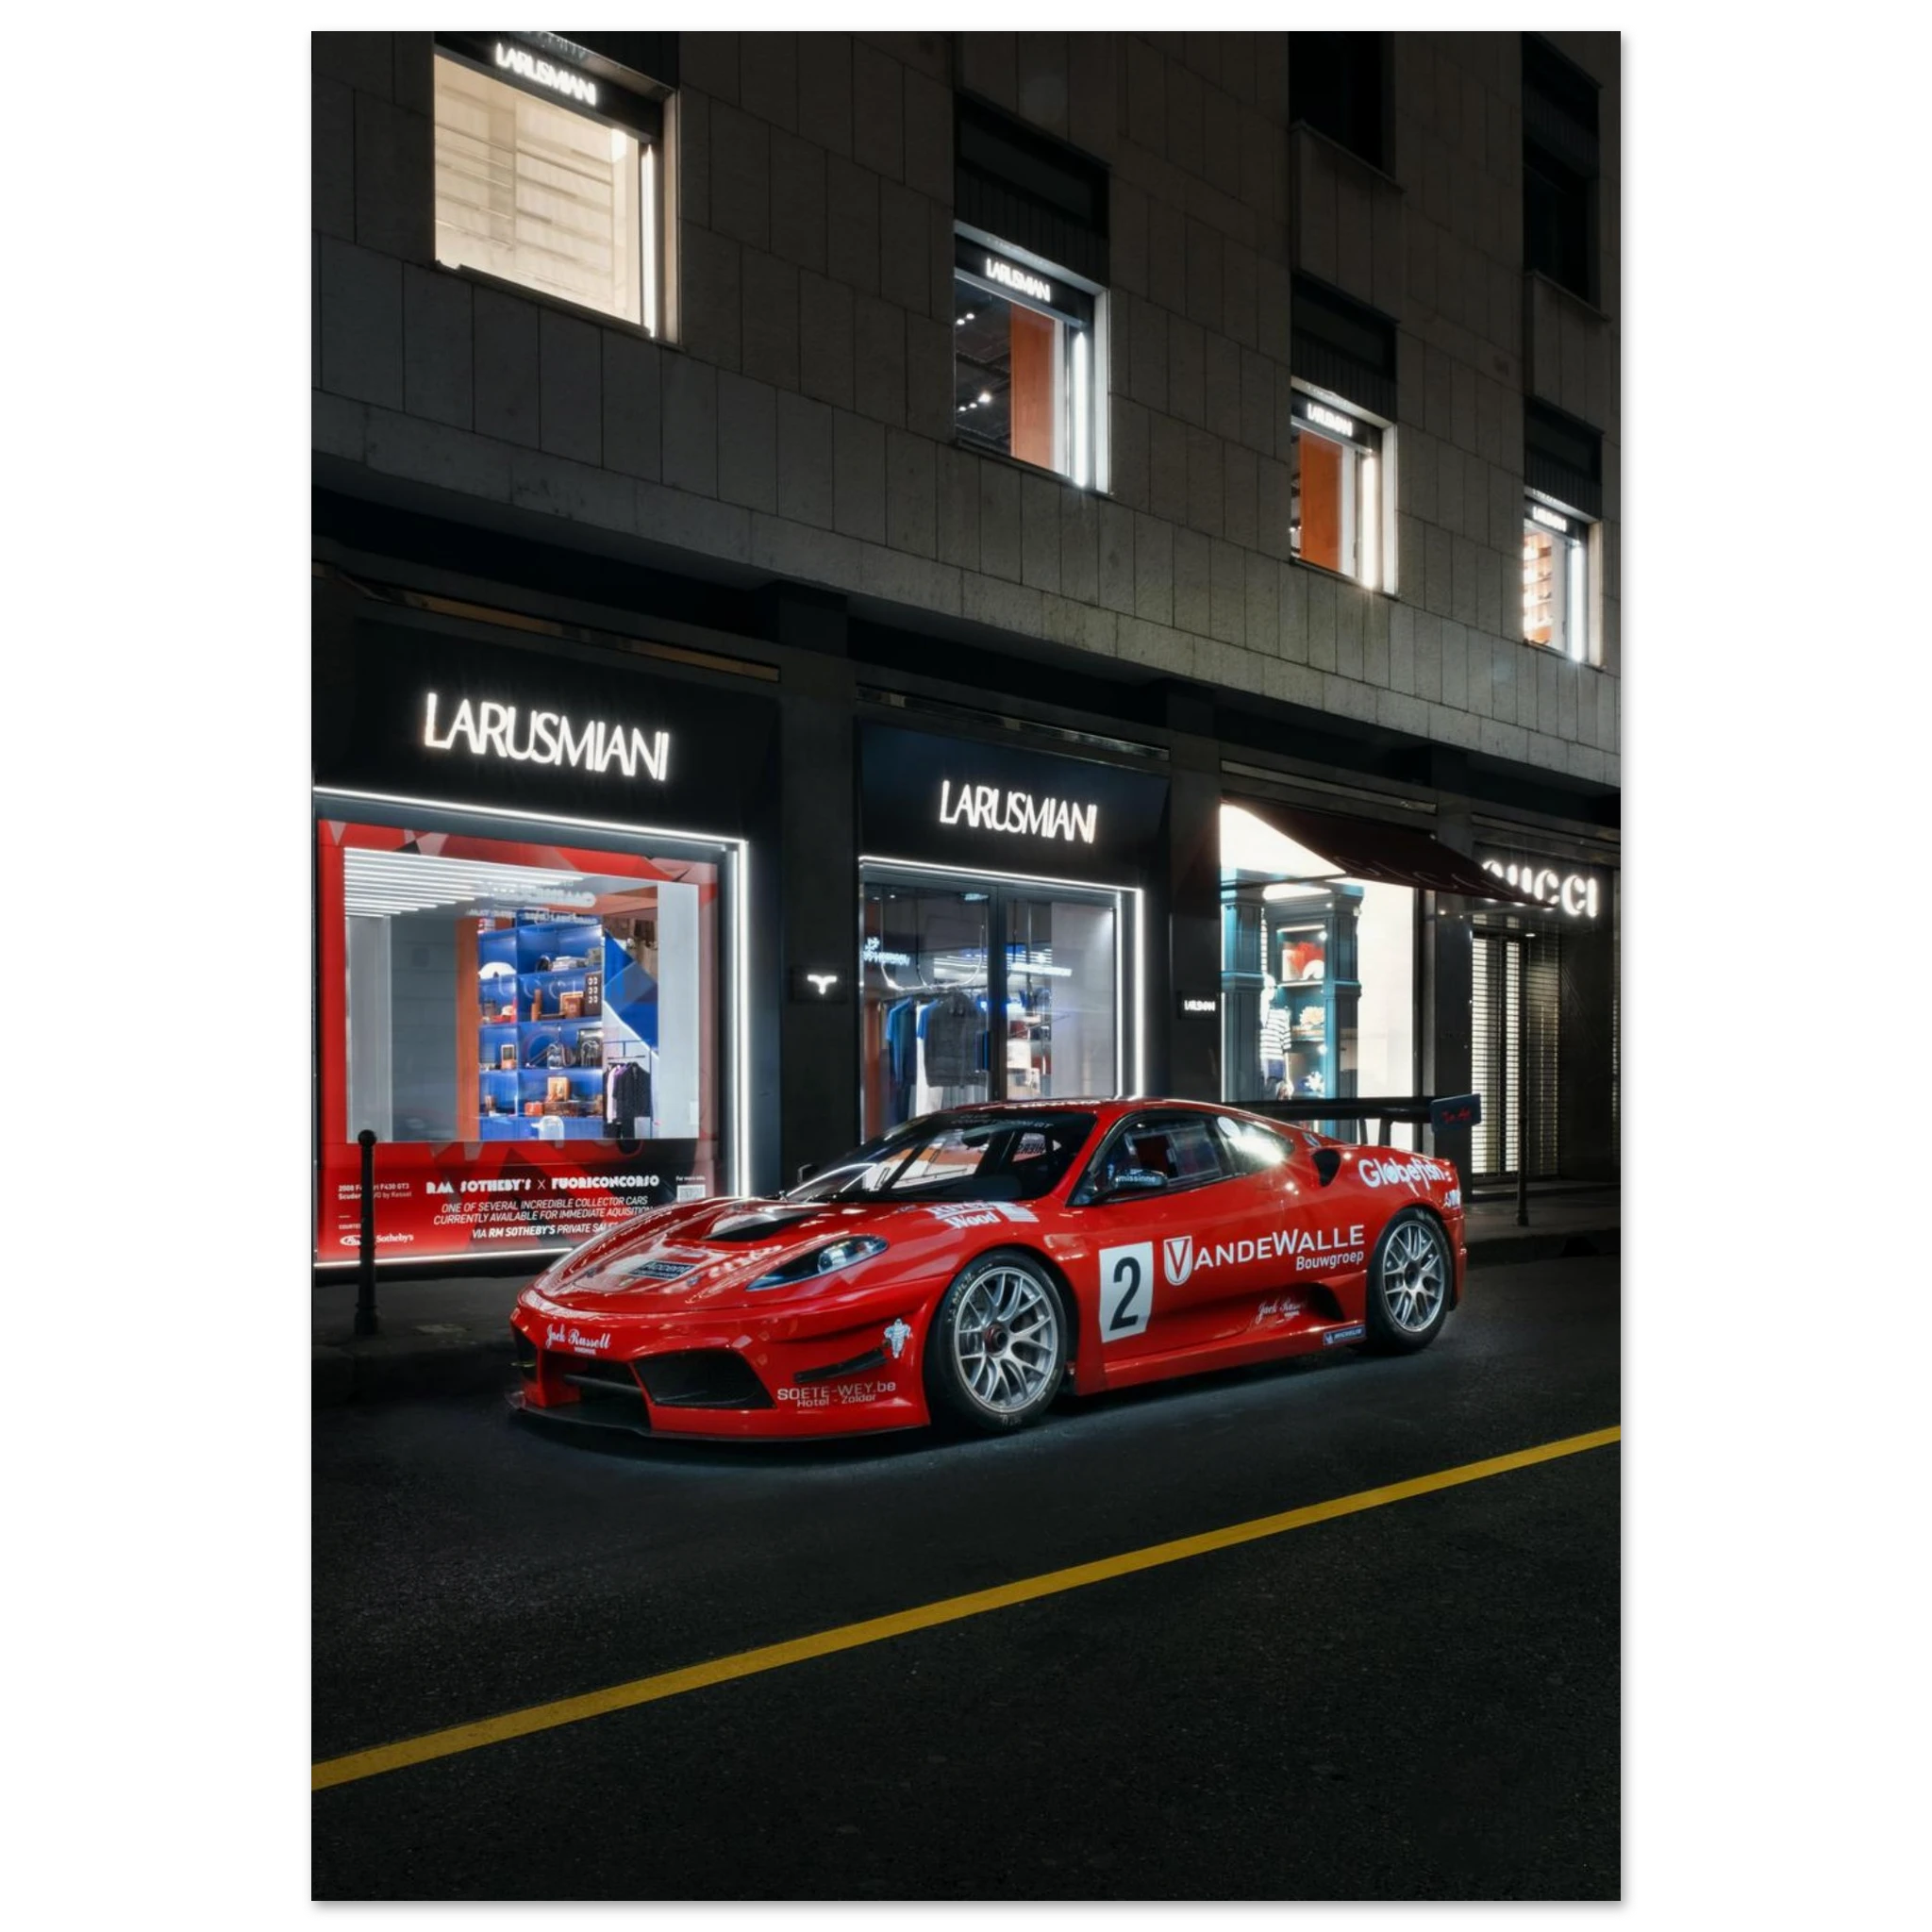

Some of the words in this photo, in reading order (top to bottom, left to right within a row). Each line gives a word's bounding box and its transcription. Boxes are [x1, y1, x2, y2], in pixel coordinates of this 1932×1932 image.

[424, 691, 670, 781] LARUSMIANI
[940, 779, 1098, 844] LARUSMIANI
[460, 1178, 531, 1193] SOTHEBY'S
[551, 1174, 660, 1190] FUORICONCORSO
[441, 1203, 461, 1213] ONE
[463, 1202, 476, 1212] OF
[477, 1200, 518, 1212] SEVERAL
[521, 1198, 574, 1210] INCREDIBLE
[575, 1197, 625, 1208] COLLECTOR
[625, 1196, 648, 1206] CARS
[433, 1213, 490, 1225] CURRENTLY
[490, 1210, 538, 1223] AVAILABLE
[539, 1209, 558, 1220] FOR
[559, 1208, 606, 1219] IMMEDIATE
[944, 1210, 1001, 1228] Wood
[472, 1228, 487, 1239] VIA
[489, 1227, 505, 1238] RM
[505, 1224, 555, 1237] SOTHEBY'S
[557, 1224, 591, 1234] PRIVATE
[1295, 1251, 1364, 1272] Bouwgroep
[1108, 1256, 1141, 1331] 2
[568, 1328, 611, 1349] Russell
[777, 1380, 896, 1400] SOETE-WEY.be
